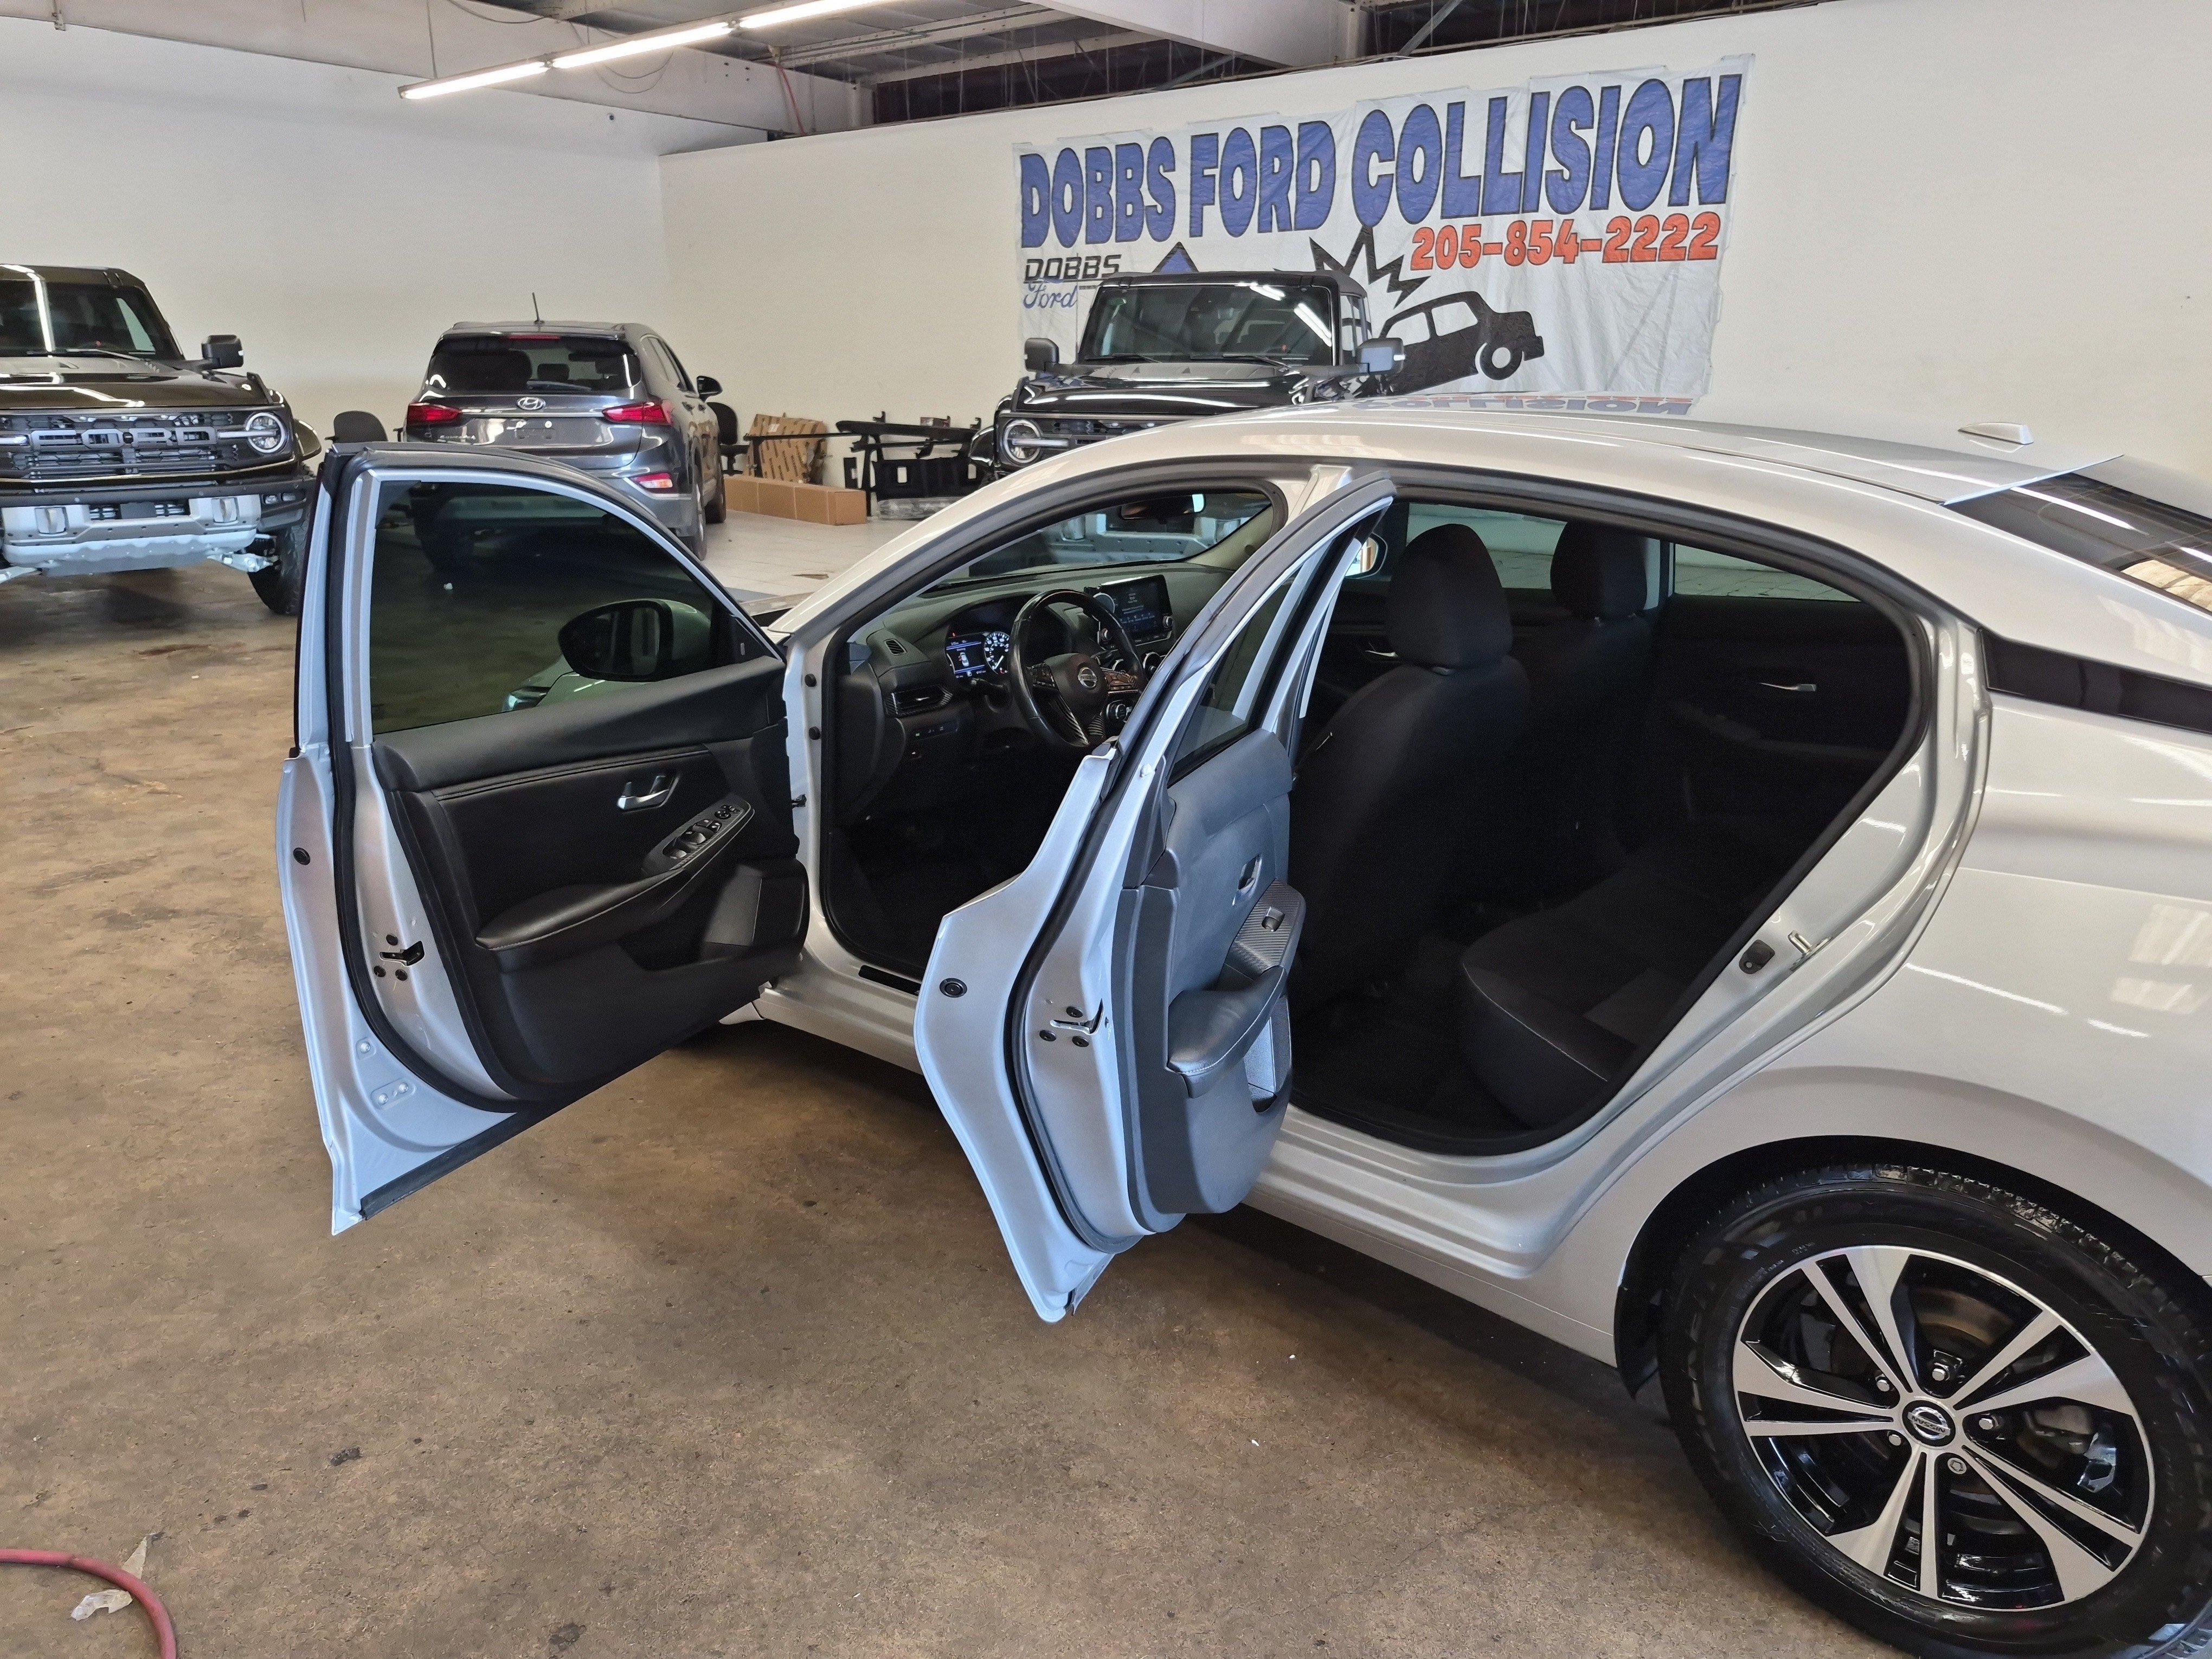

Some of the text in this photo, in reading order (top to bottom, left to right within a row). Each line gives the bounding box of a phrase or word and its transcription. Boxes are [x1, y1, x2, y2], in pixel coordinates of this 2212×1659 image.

[1020, 74, 1742, 248] DOBBS FORD COLLISION
[1410, 211, 1721, 270] 205-854-2222
[1024, 254, 1122, 281] DOBBS
[1023, 280, 1077, 309] Ford
[30, 427, 217, 449] FORD
[1911, 1416, 1946, 1433] NISSAN
